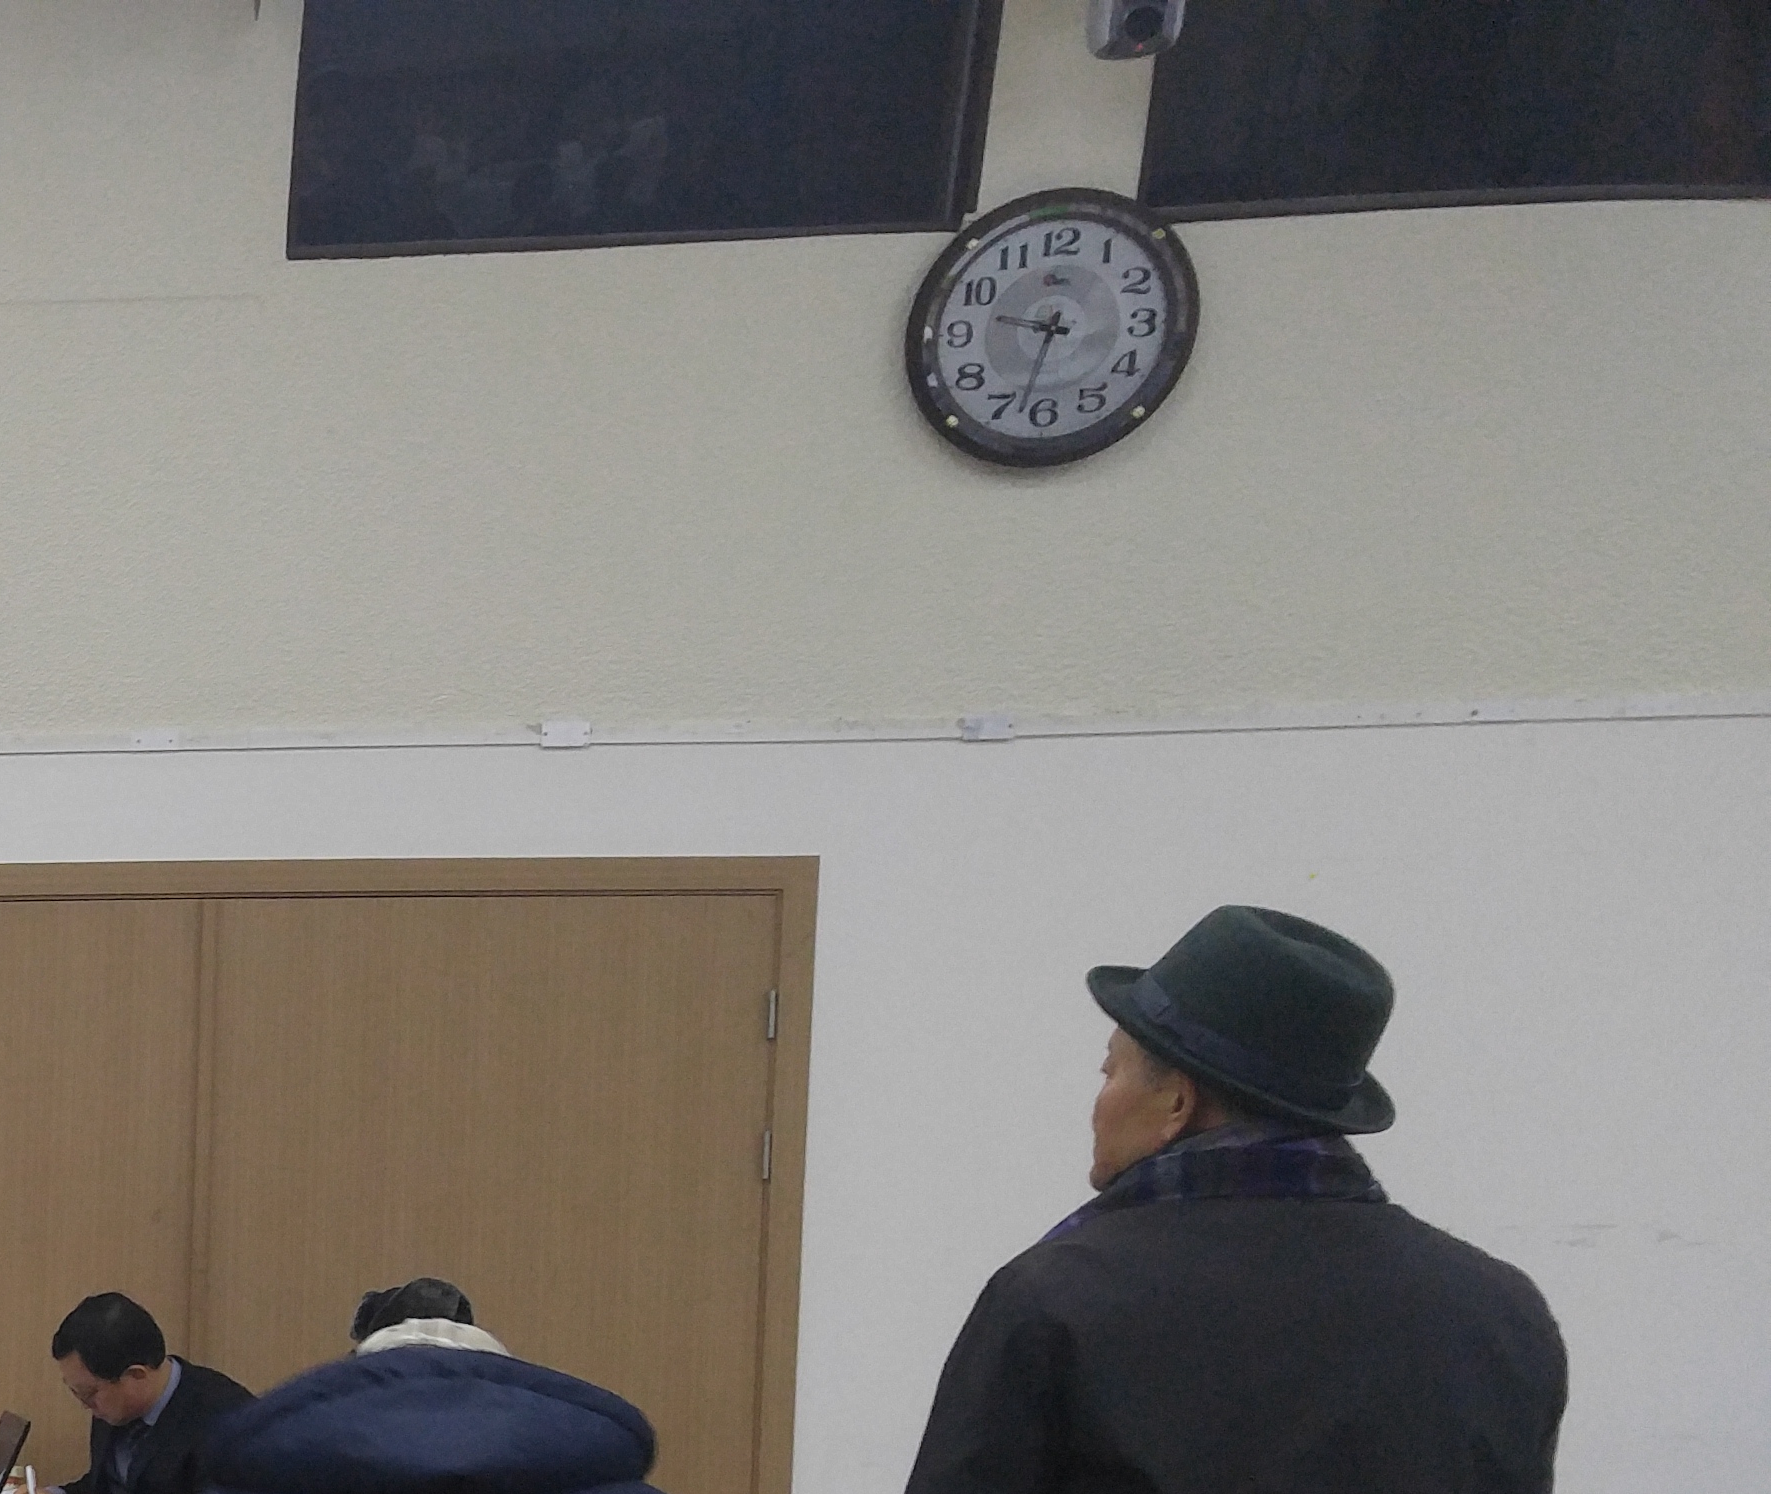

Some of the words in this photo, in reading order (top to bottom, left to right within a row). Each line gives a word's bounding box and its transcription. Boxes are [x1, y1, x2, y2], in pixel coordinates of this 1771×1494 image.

[1042, 227, 1081, 257] 12
[1102, 238, 1112, 264] 1
[998, 243, 1028, 270] 11
[963, 276, 997, 305] 10
[1121, 267, 1151, 294] 2
[946, 320, 973, 348] 9
[1127, 308, 1157, 337] 3
[955, 363, 985, 390] 8
[1111, 350, 1141, 377] 4
[987, 393, 1016, 420] 7
[1077, 382, 1108, 413] 5
[1028, 398, 1058, 427] 6
